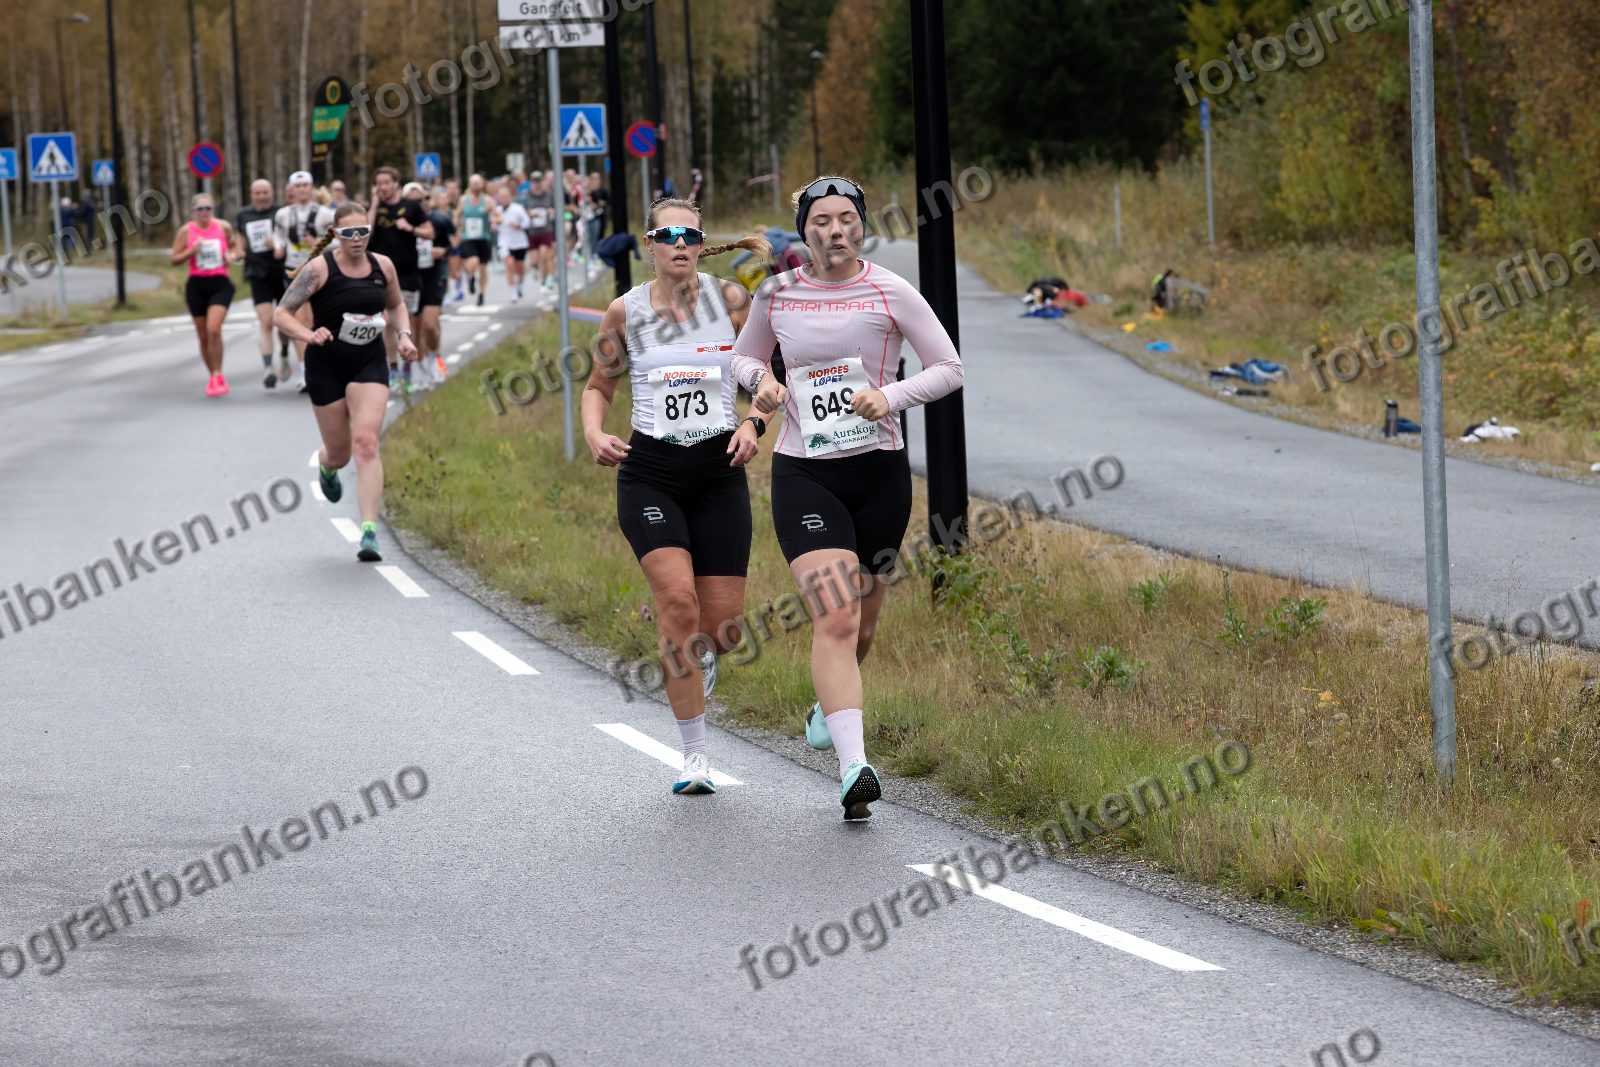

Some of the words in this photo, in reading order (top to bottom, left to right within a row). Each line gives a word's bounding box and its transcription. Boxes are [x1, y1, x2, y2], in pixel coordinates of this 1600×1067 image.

[781, 301, 821, 313] KARI
[823, 301, 875, 312] TRAA
[349, 326, 377, 340] 420
[663, 371, 708, 382] NORGES
[807, 364, 850, 380] NORGES
[668, 378, 702, 388] LØPET
[813, 374, 844, 388] LØPET
[664, 389, 709, 421] 873
[811, 387, 856, 422] 649
[833, 425, 876, 440] Aurskog
